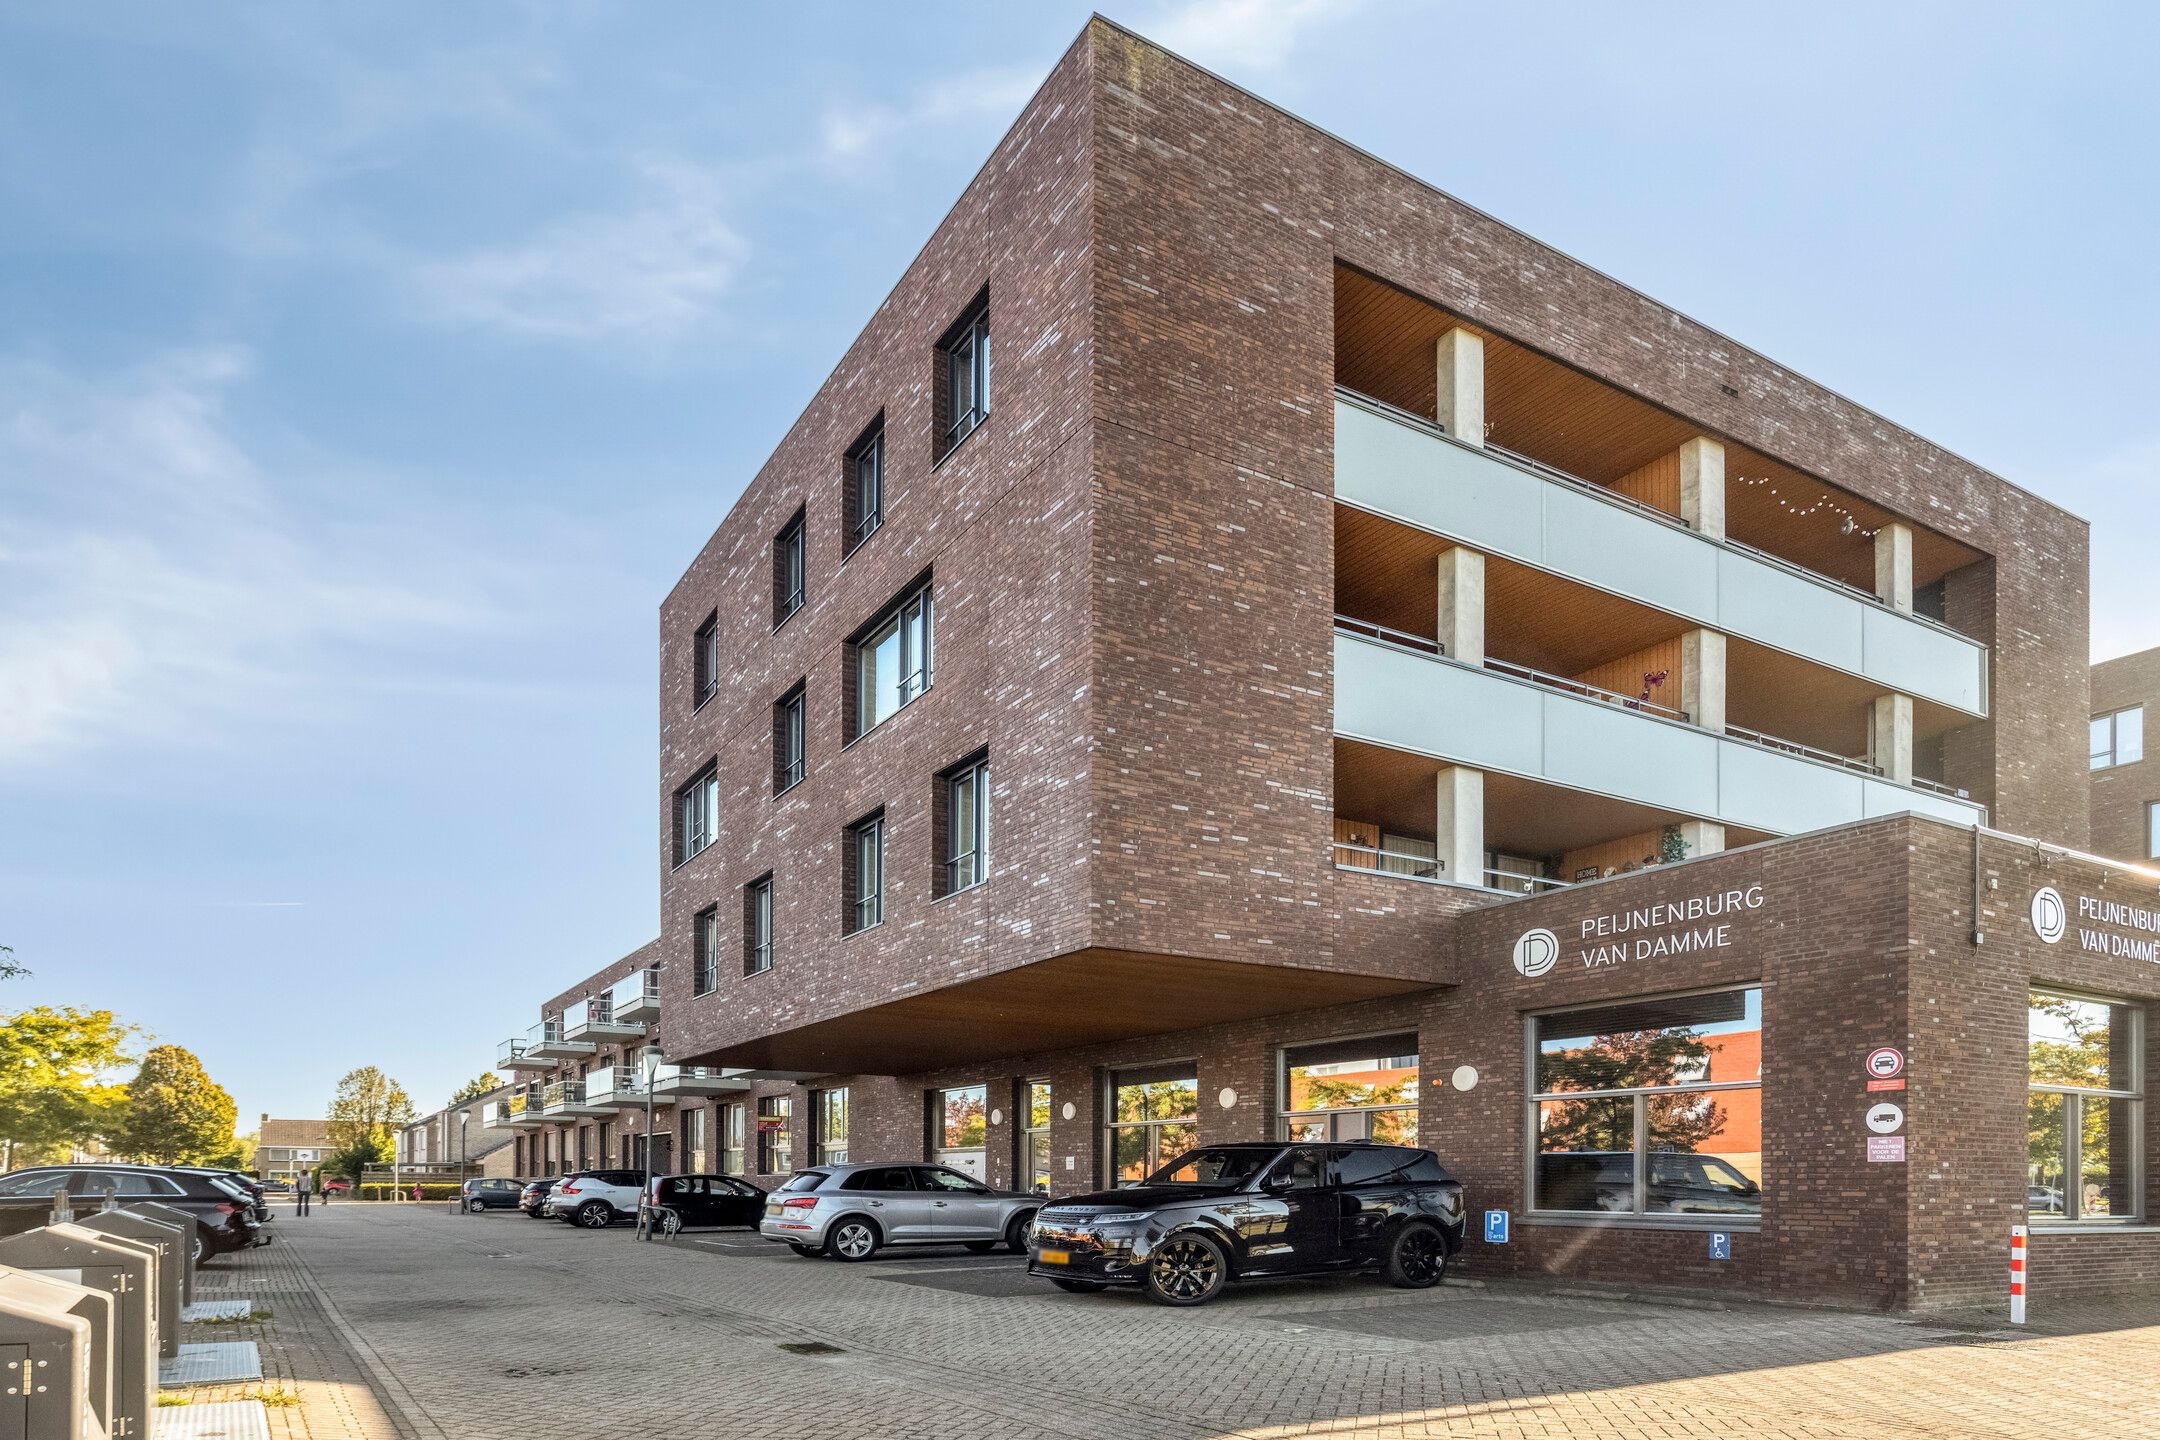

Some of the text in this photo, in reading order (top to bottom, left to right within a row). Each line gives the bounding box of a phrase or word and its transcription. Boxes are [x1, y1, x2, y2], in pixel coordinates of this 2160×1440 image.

[1581, 886, 1765, 939] PEIJNENBURG
[1581, 924, 1732, 968] VAN DAMME
[2079, 928, 2160, 964] VAN DAMME
[1490, 1213, 1502, 1230] P
[1713, 1233, 1725, 1248] P
